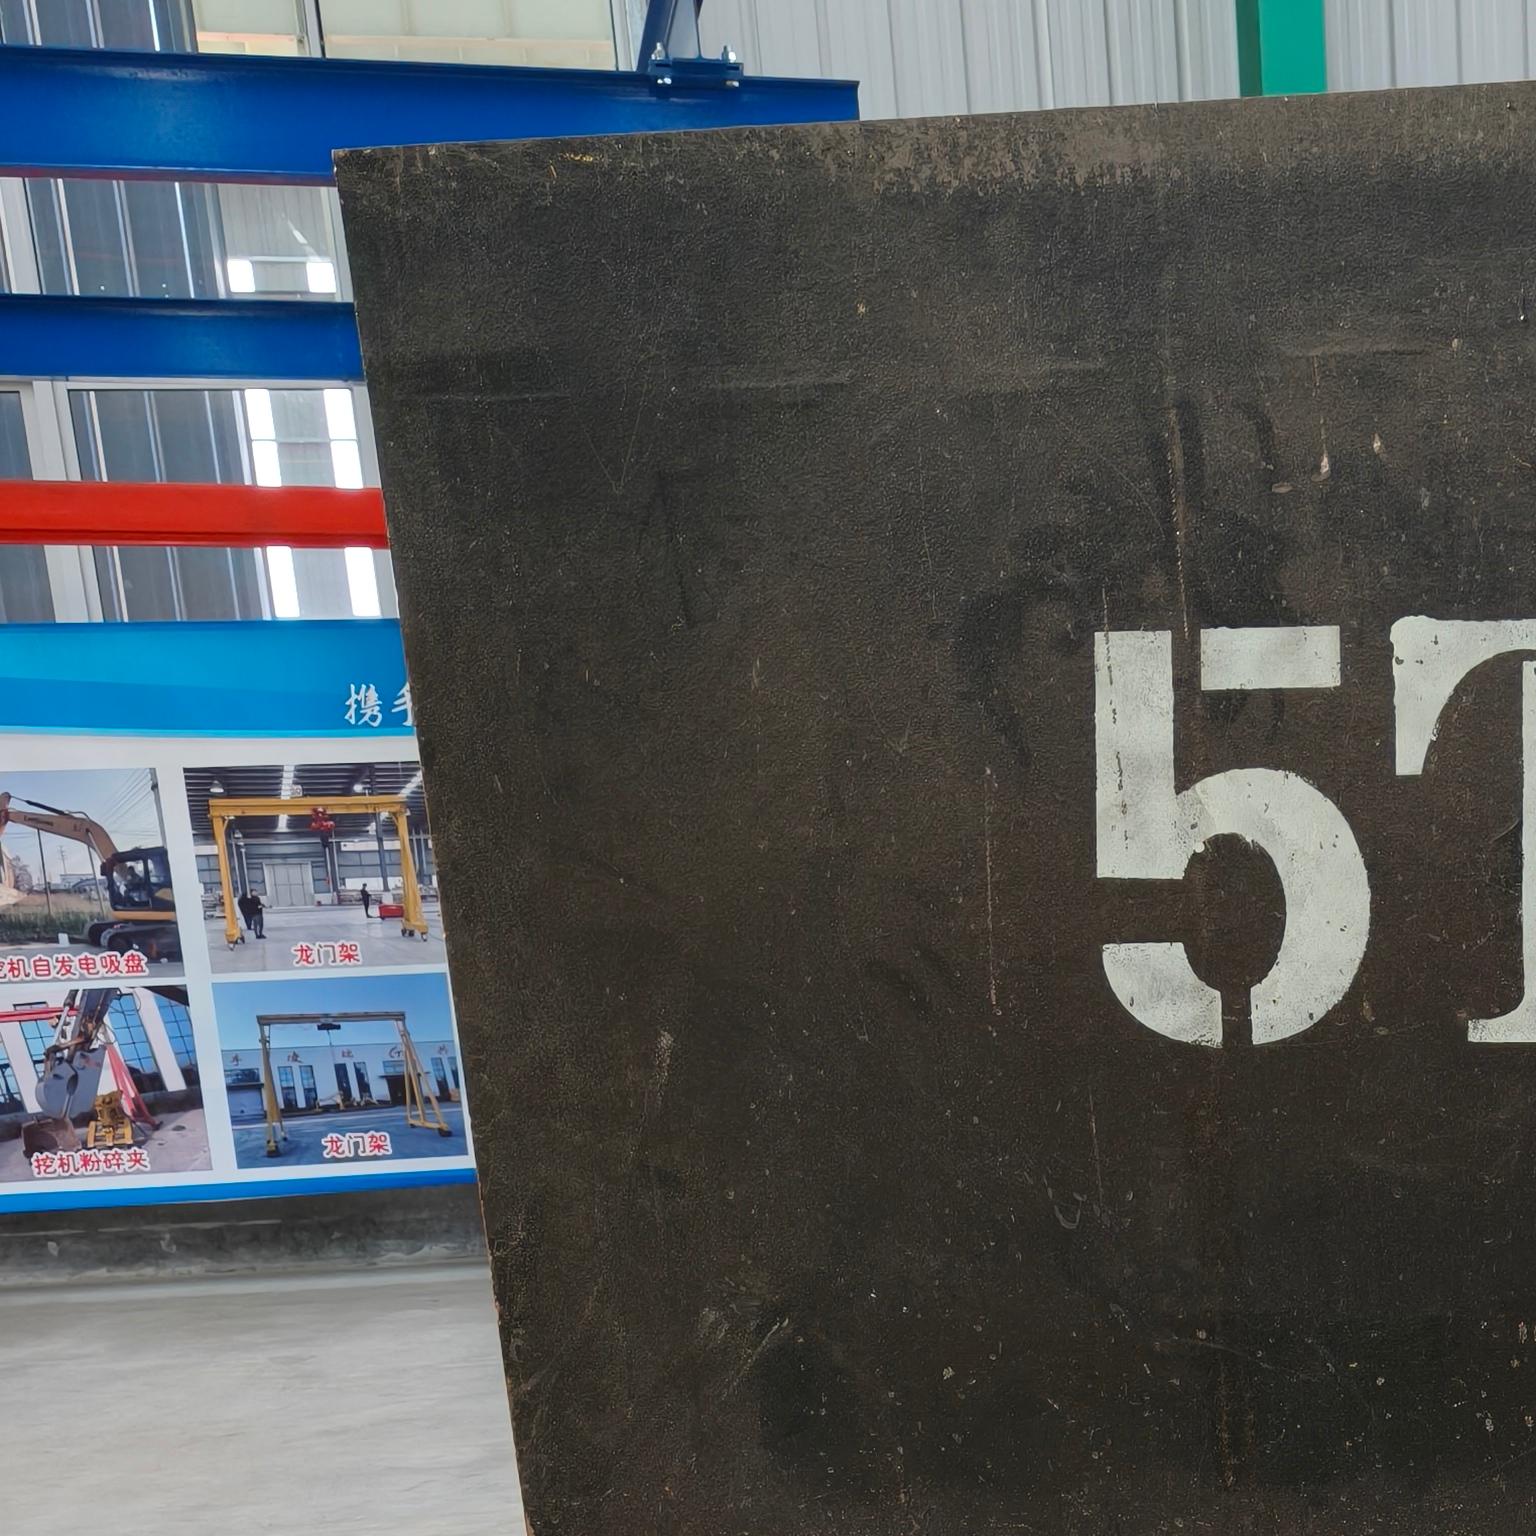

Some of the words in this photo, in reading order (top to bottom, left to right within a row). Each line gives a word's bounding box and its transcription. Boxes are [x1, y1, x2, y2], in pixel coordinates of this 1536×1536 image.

[293, 942, 361, 965] 龙门架
[323, 1133, 391, 1156] 龙门架
[34, 1150, 149, 1176] 挖机粉碎夹
